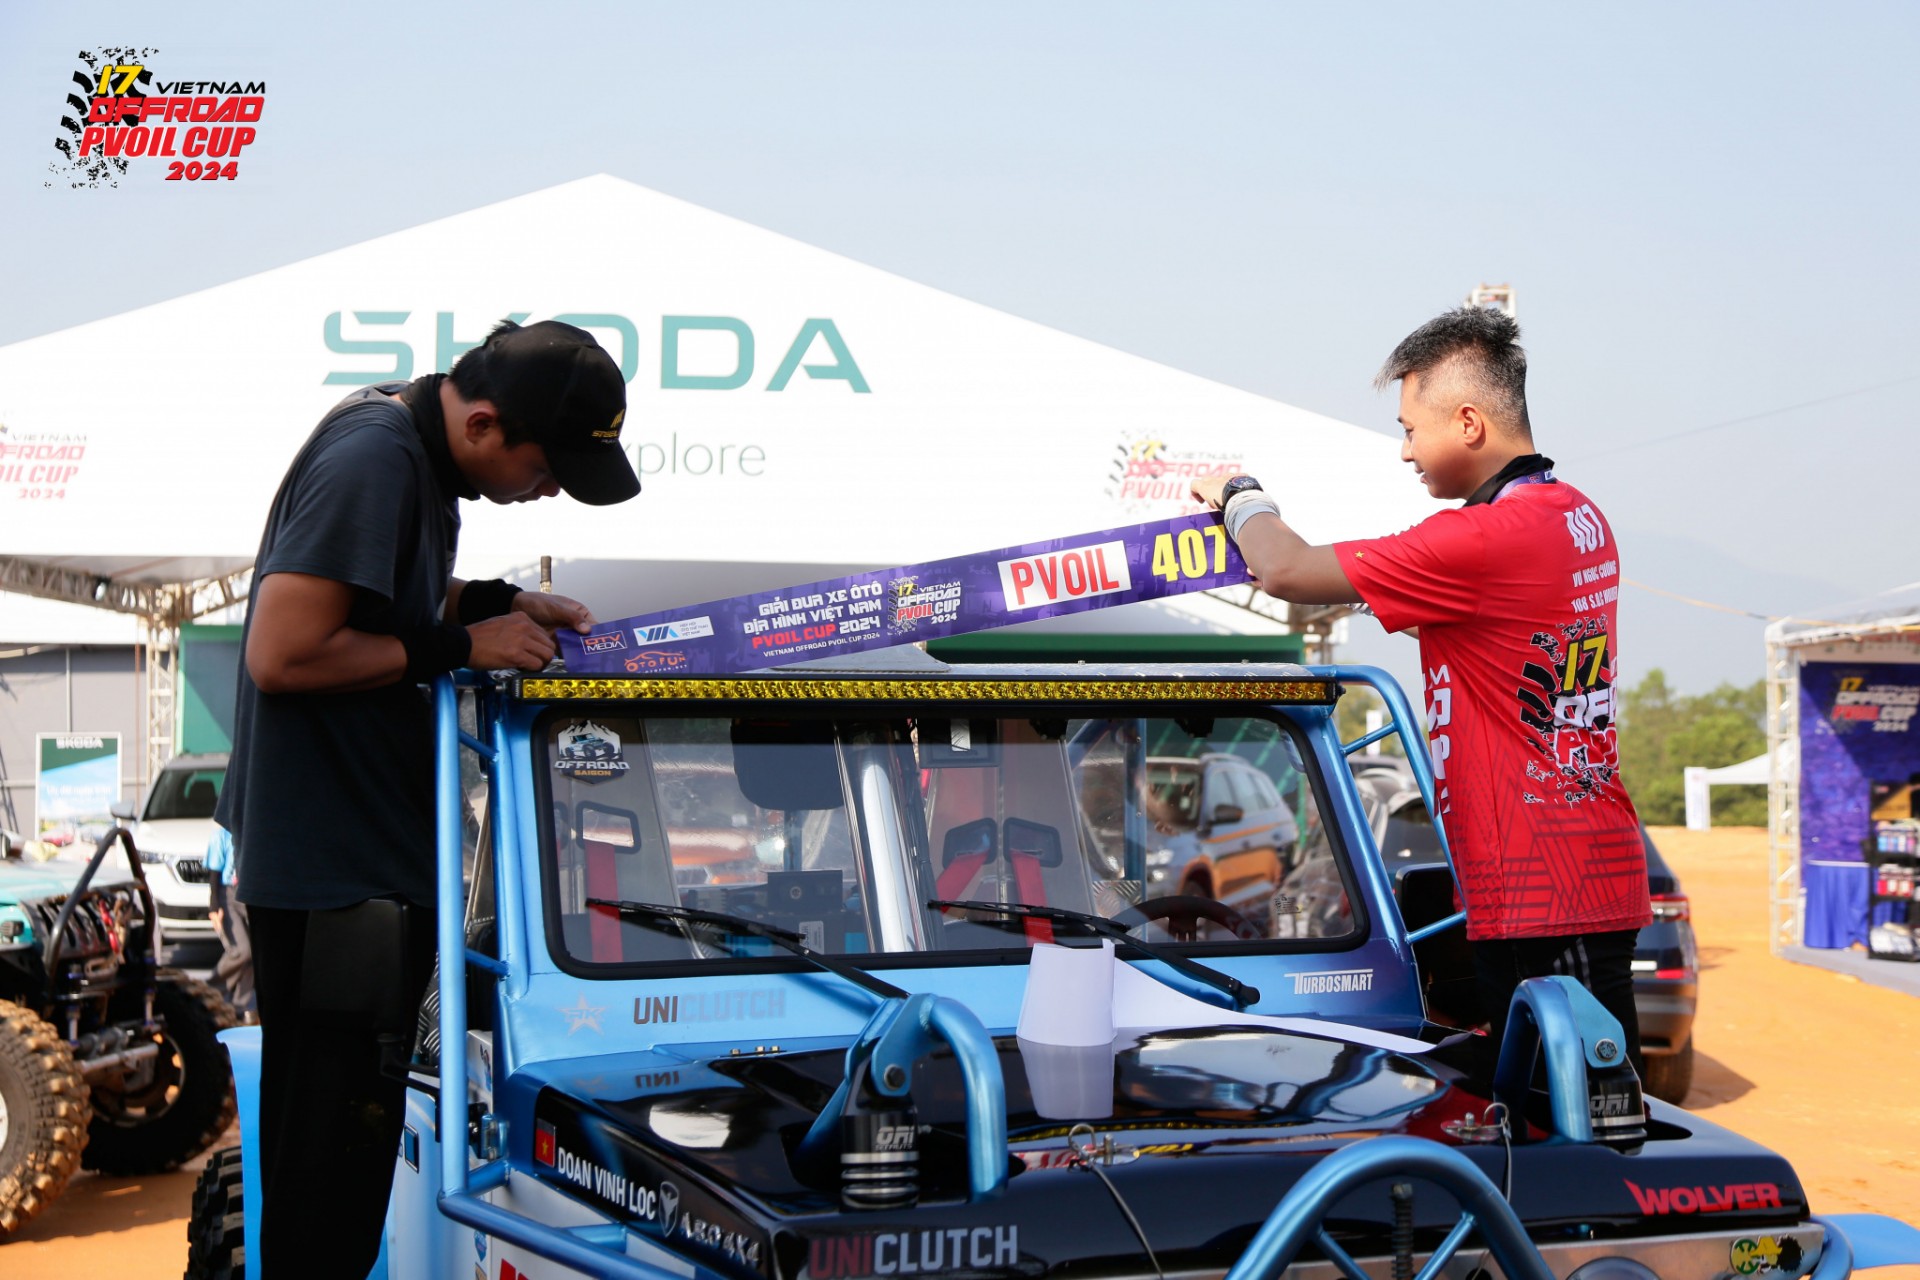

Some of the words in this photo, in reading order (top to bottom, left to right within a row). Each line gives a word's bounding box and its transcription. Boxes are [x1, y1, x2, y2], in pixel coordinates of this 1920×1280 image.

[624, 431, 766, 478] plore
[1130, 440, 1164, 461] 17
[28, 465, 79, 483] CUP
[18, 488, 66, 499] 2024
[1120, 480, 1184, 501] PVOIL
[1563, 503, 1605, 555] 407
[1152, 525, 1228, 583] 407
[919, 581, 961, 593] VIETNAM
[1009, 547, 1120, 606] PVOIL
[826, 589, 848, 604] XE
[850, 580, 883, 599] ÔTÔ
[898, 583, 914, 596] 17
[898, 587, 961, 608] OFFROAD
[771, 611, 807, 629] HÌNH
[809, 605, 844, 622] VIỆT
[848, 599, 882, 615] NAM
[897, 603, 934, 622] PVOIL
[934, 599, 961, 615] CUP
[931, 612, 957, 625] 2024
[751, 630, 802, 649] PVOIL
[803, 623, 836, 641] CUP
[838, 616, 881, 634] 2024
[763, 647, 795, 657] VIETNAM
[795, 641, 827, 652] OFFROAD
[828, 637, 848, 647] PVOIL
[848, 635, 862, 644] CUP
[863, 632, 881, 641] 2024
[587, 641, 625, 651] MEDIA
[1562, 634, 1608, 692] 17
[554, 760, 631, 770] OFFROAD
[1283, 969, 1374, 995] TURBOSMART
[634, 988, 786, 1025] UNICLUTCH
[558, 1146, 592, 1190] DOAN
[594, 1165, 627, 1207] VINH
[629, 1182, 657, 1220] LOC
[1624, 1179, 1783, 1216] WOLVER
[809, 1225, 1018, 1279] UNICLUTCH
